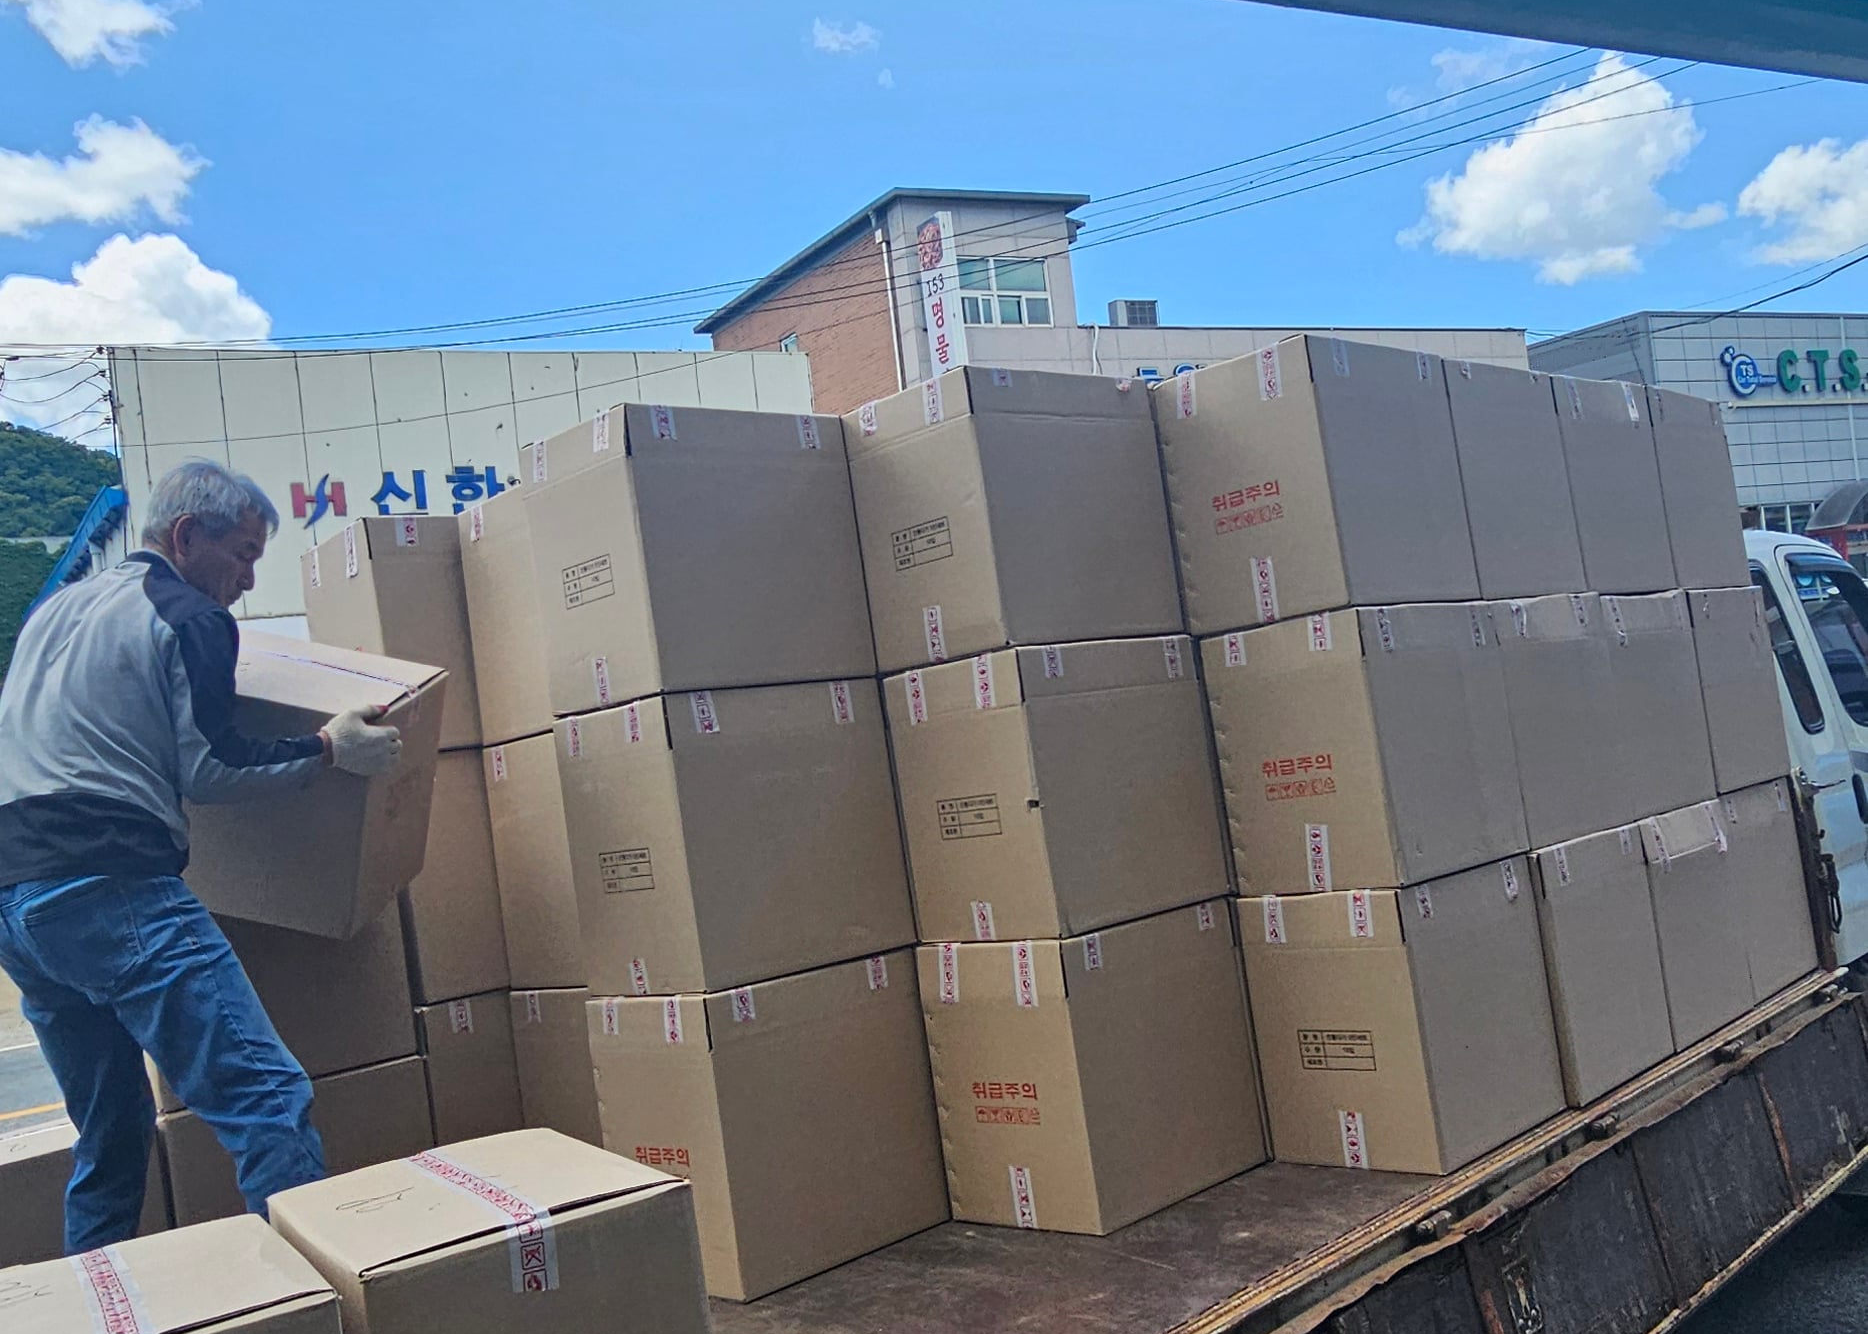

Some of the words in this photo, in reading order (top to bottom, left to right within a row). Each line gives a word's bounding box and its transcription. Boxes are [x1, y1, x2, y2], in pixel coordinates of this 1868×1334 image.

[931, 297, 950, 372] 명물
[370, 466, 505, 515] 신한
[1211, 479, 1280, 512] 취급주의
[1262, 754, 1332, 778] 취급주의
[972, 1082, 1038, 1100] 취급주의
[635, 1146, 690, 1168] 취급주의
